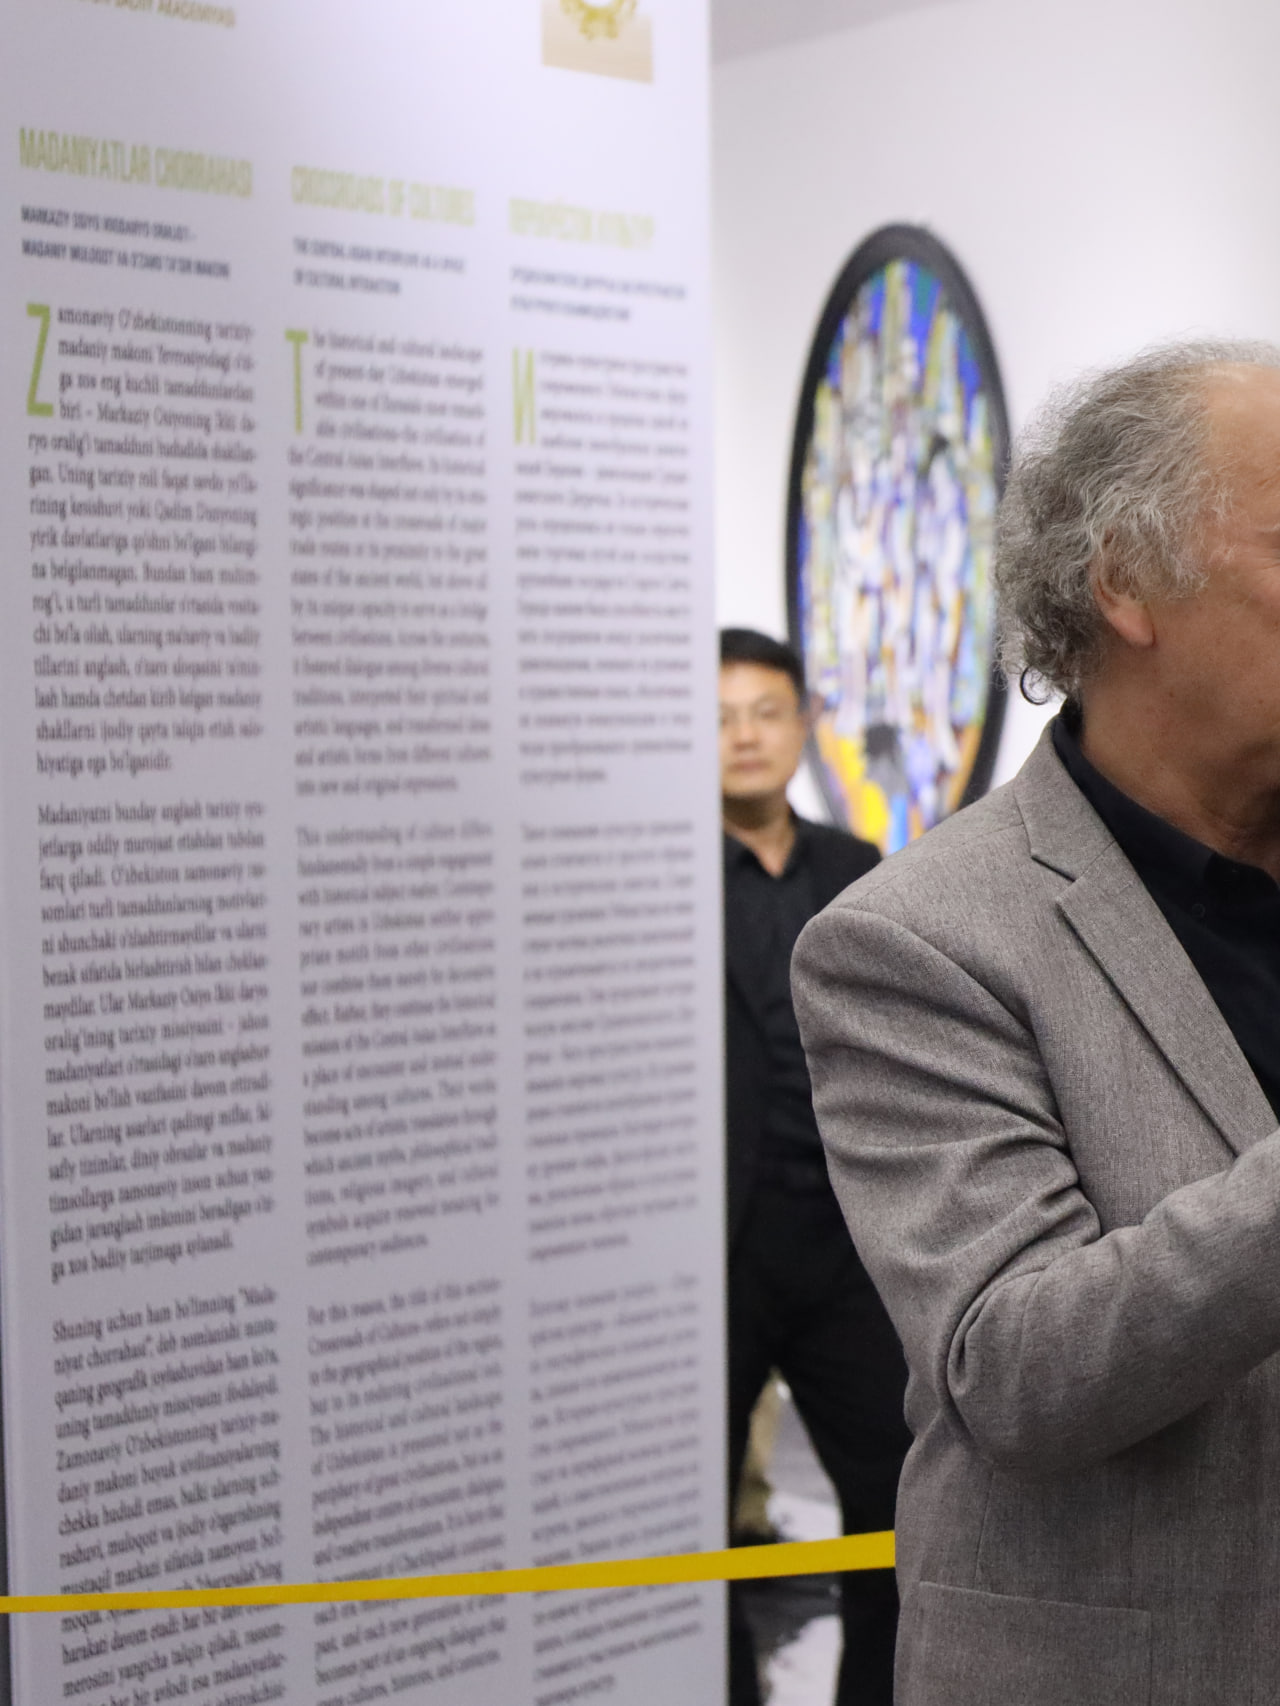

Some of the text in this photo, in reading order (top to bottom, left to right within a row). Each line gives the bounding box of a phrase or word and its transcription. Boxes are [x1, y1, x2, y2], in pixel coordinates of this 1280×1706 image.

[19, 126, 150, 185] MADANIYATLAR
[27, 437, 48, 458] ryo
[57, 464, 95, 491] Uning
[28, 496, 67, 522] rining
[69, 497, 123, 519] kesishuvi
[29, 529, 58, 555] yirik
[76, 593, 101, 614] turli
[32, 625, 51, 647] chi
[33, 658, 79, 679] tillarini
[34, 690, 58, 712] lash
[61, 689, 101, 711] hamda
[35, 721, 95, 744] shakllarni
[35, 753, 107, 781] hiyatiga ega
[37, 803, 111, 833] Madaniyatni
[37, 837, 83, 866] jetlarga
[87, 834, 119, 862] oddiy
[38, 870, 65, 898] farq
[40, 901, 85, 925] somlari
[87, 898, 113, 921] turli
[56, 930, 116, 956] shunchaki
[41, 965, 77, 990] bezak
[79, 961, 122, 986] sifatida
[45, 1092, 91, 1119] makoni
[69, 1120, 122, 1153] Ularning
[47, 1159, 76, 1189] safiy
[48, 1185, 115, 1221] timsollarga
[49, 1222, 83, 1253] gidan
[85, 1212, 143, 1247] jaranglash
[68, 1259, 89, 1278] xos
[90, 1247, 126, 1279] badiiy
[52, 1314, 103, 1350] Shuning
[53, 1350, 84, 1382] niyat
[54, 1380, 94, 1415] qaning
[54, 1413, 90, 1447] uning
[55, 1438, 121, 1479] Zamonaviy
[56, 1477, 90, 1511] daniy
[93, 1466, 137, 1497] makoni
[57, 1508, 99, 1539] chekka
[102, 1497, 143, 1528] hududi
[61, 1634, 108, 1668] harakati
[64, 1664, 114, 1700] merosini
